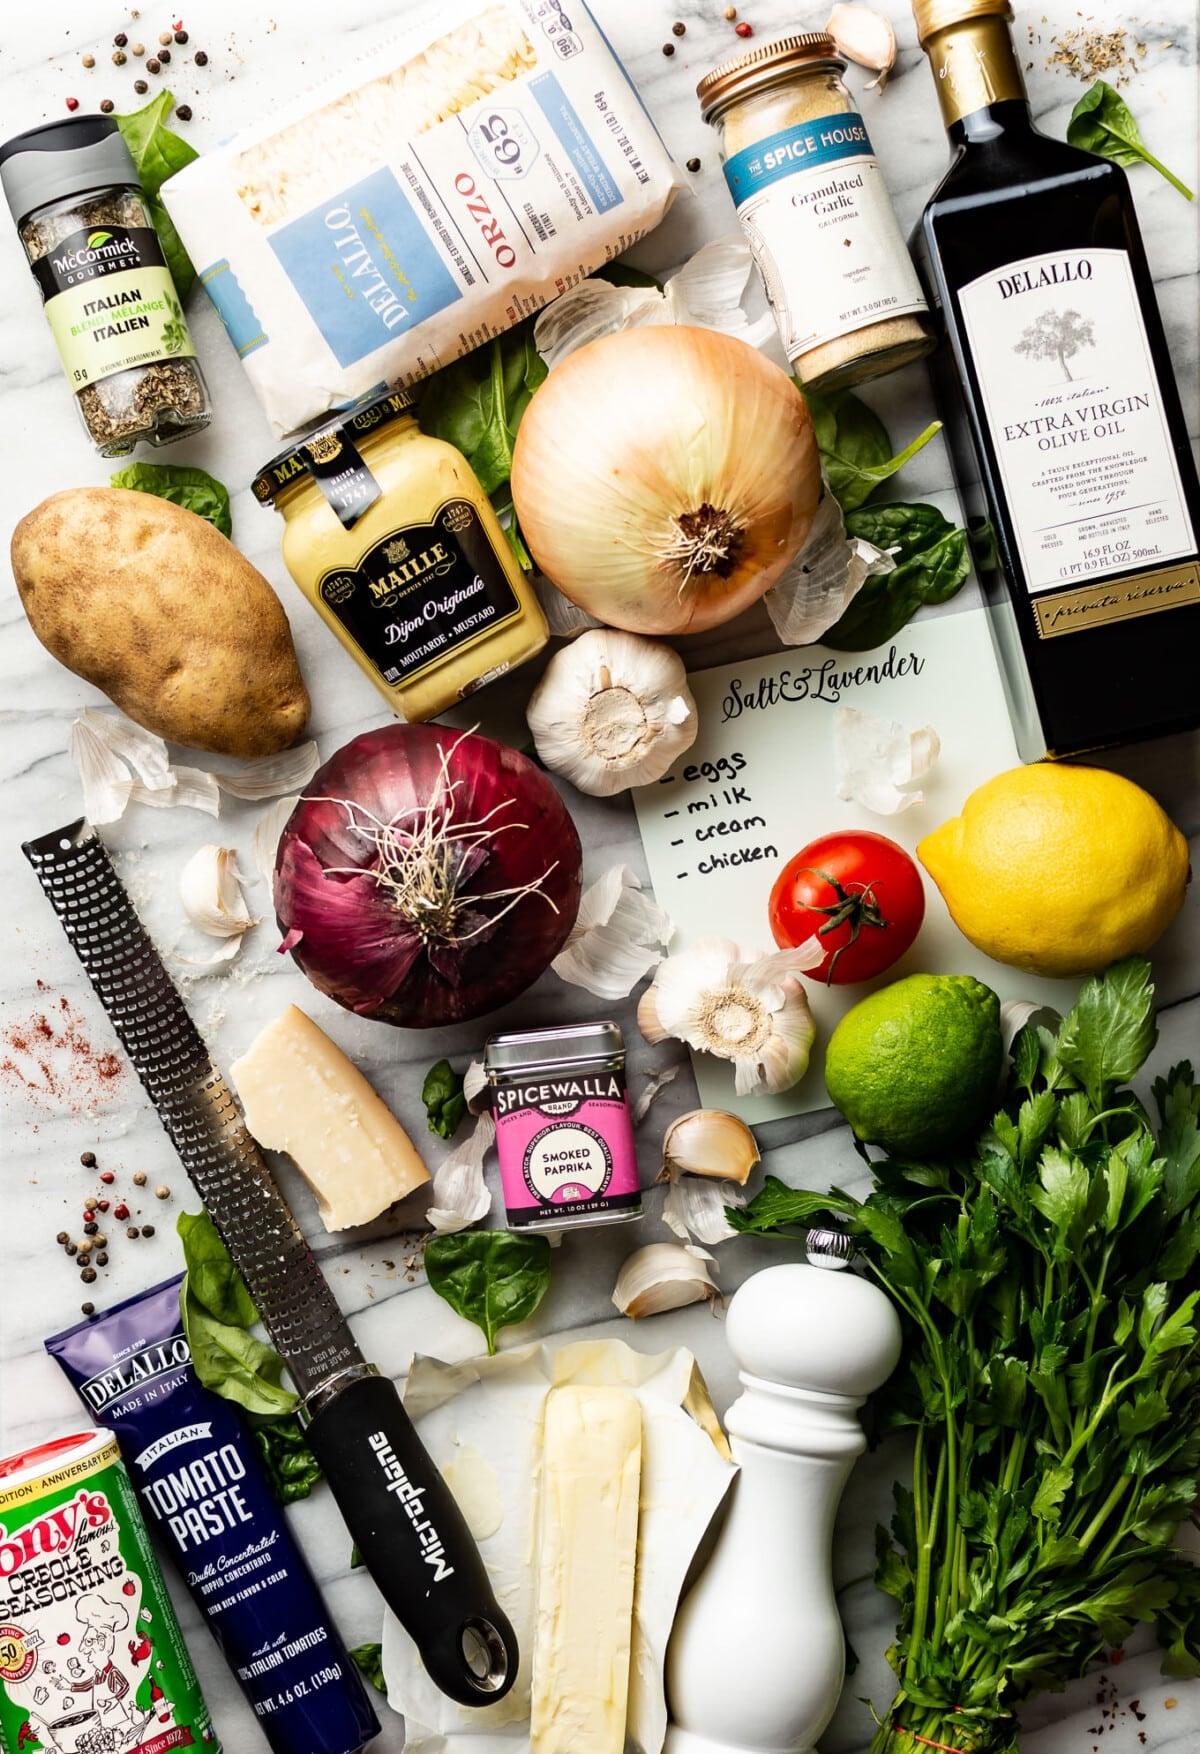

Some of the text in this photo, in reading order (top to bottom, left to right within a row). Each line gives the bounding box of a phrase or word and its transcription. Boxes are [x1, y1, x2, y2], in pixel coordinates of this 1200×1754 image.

[555, 37, 573, 57] 190
[591, 90, 609, 112] 454g
[480, 114, 521, 165] 65
[622, 145, 634, 156] 16
[763, 126, 866, 170] SPICE HOUSE
[399, 161, 419, 186] TEXTURE
[627, 154, 642, 169] WT.
[634, 168, 650, 184] NET
[748, 162, 761, 173] THE
[562, 188, 571, 198] in
[568, 176, 576, 186] in
[572, 184, 588, 206] dente
[790, 173, 863, 207] Granulated
[567, 196, 584, 220] Ready
[583, 205, 593, 215] Al
[813, 195, 853, 214] Garlic
[818, 211, 859, 228] CALIFORNIA
[454, 172, 516, 269] ORZO
[53, 236, 139, 275] McCormick
[458, 264, 476, 286] BRONZE
[70, 298, 165, 336] BLEND MÉLANGE
[83, 288, 142, 316] ITALIAN
[839, 311, 850, 320] NET
[92, 314, 149, 342] ITALIEN
[73, 369, 81, 382] 13
[1003, 393, 1150, 441] EXTRA VIRGIN
[1037, 419, 1125, 451] OLIVE OIL
[1031, 456, 1147, 487] CRAFTED FROM THE KNOWLEDGE
[1047, 464, 1070, 474] TRULY
[1072, 453, 1120, 469] EXCEPTIONAL
[340, 483, 368, 507] 1747
[1049, 468, 1134, 493] PASSED DOWN THROUGH
[1058, 490, 1076, 499] FOUR
[1069, 563, 1082, 574] PT
[1084, 559, 1097, 570] 0.9
[1099, 556, 1111, 566] FL
[1112, 551, 1130, 563] OZ)
[1132, 544, 1161, 558] 500mL
[1083, 540, 1130, 559] 16.9 FL OZ
[367, 540, 450, 601] MAILLE
[397, 572, 435, 599] DEPUIS 1747
[384, 575, 484, 643] Dijon Originale
[399, 604, 496, 668] MOUTARDE MUSTARD
[683, 751, 747, 783] eggs
[686, 784, 751, 814] milk
[694, 812, 766, 842] cream
[698, 843, 778, 874] chicken
[497, 1076, 621, 1112] SPICEWALLA
[547, 1102, 572, 1111] BRAND
[527, 1128, 550, 1153] SUPERIOR
[583, 1127, 597, 1138] BEST
[600, 1168, 612, 1191] ALWAYS
[542, 1148, 590, 1162] SMOKED
[544, 1161, 592, 1175] PAPRIKA
[111, 1338, 147, 1360] SINCE 1950
[305, 1346, 350, 1377] BLADE MADE
[311, 1344, 336, 1363] IN USA
[111, 1372, 190, 1419] MADE IN ITALY
[146, 1427, 199, 1460] ITALIAN
[0, 1454, 102, 1503] DITION ANNIVERSARY
[140, 1441, 248, 1522] TOMATO
[167, 1482, 254, 1554] PASTE
[366, 1428, 456, 1583] Microplane
[0, 1493, 111, 1577] ony's
[73, 1518, 116, 1551] famous
[8, 1548, 92, 1594] CREOLE
[187, 1529, 277, 1586] Double Concentrated
[201, 1551, 272, 1595] DOPPIO CONCENTRATO
[0, 1556, 124, 1621] SEASONING
[207, 1602, 222, 1616] EXTRA
[221, 1595, 237, 1609] RICH
[236, 1582, 261, 1601] FLAVOR
[266, 1568, 288, 1585] COLOR
[0, 1643, 17, 1666] 50
[249, 1649, 284, 1677] ITALIAN
[281, 1625, 328, 1660] TOMATOES
[251, 1631, 287, 1657] made with
[254, 1661, 343, 1716] NET WT. 4.6 OZ. (130g)
[145, 1739, 166, 1754] Since
[165, 1728, 183, 1747] 1972
